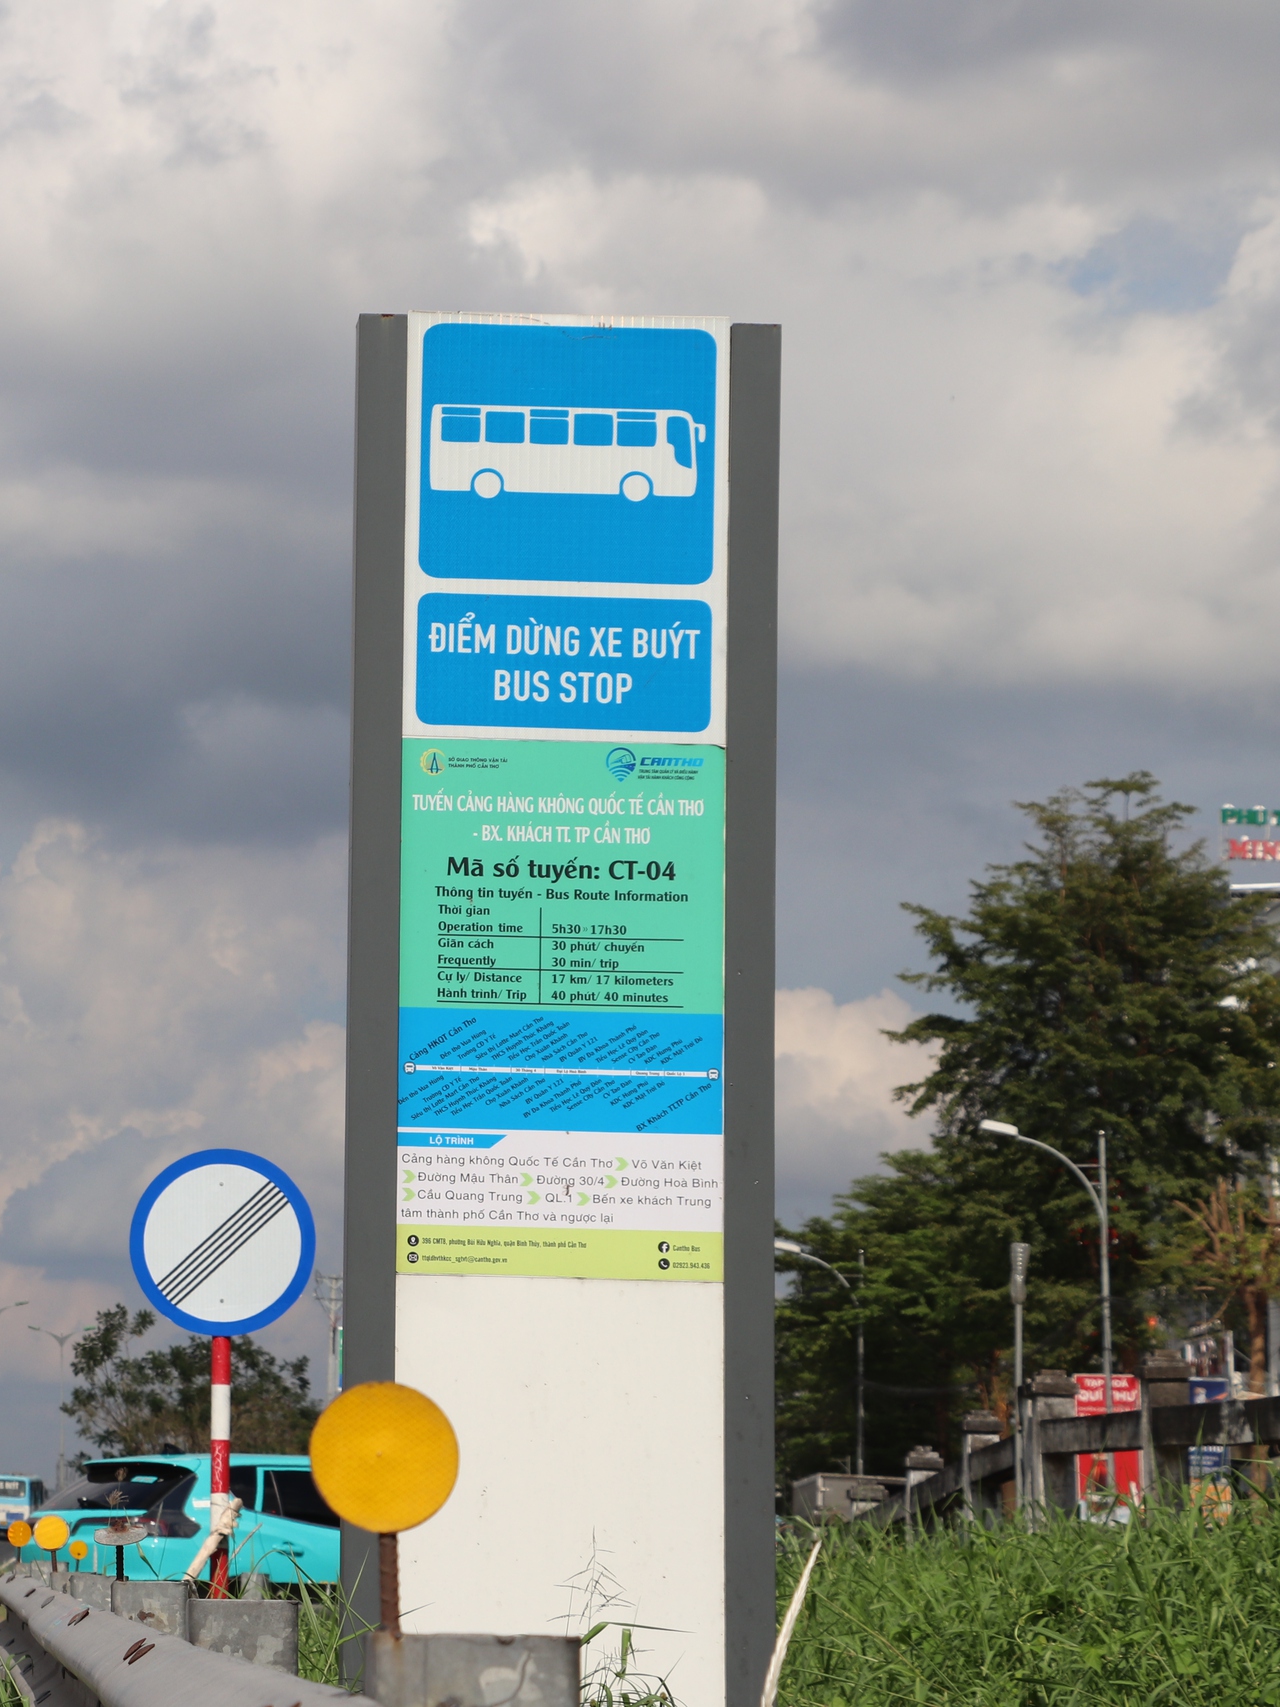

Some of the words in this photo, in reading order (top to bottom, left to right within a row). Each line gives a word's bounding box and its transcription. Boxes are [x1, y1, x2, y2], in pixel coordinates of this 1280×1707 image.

[429, 612, 495, 654] ĐIỂM
[506, 617, 580, 657] DỪNG
[589, 626, 623, 658] XE
[632, 621, 701, 659] BUÝT
[494, 669, 550, 702] BUS
[559, 671, 633, 704] STOP
[640, 757, 704, 767] CANTHO
[411, 787, 453, 811] TUYẾN
[456, 789, 493, 812] CẢNG
[496, 791, 534, 813] HÀNG
[537, 792, 584, 814] KHÔNG
[587, 790, 625, 816] QUỐC
[627, 791, 644, 815] TẾ
[646, 791, 674, 816] CẦN
[676, 798, 704, 816] THƠ
[481, 824, 503, 842] BX.
[506, 820, 552, 842] KHÁCH
[554, 825, 571, 843] TT.
[573, 826, 590, 843] TP
[592, 819, 621, 844] CẦN
[623, 826, 651, 844] THƠ
[446, 856, 484, 877] Mã
[492, 854, 520, 878] số
[526, 856, 600, 883] tuyến:
[607, 859, 676, 881] CT-04
[434, 885, 473, 901] Thông
[476, 886, 494, 898] tin
[497, 886, 532, 901] tuyến
[545, 887, 570, 900] Bus
[573, 888, 610, 901] Route
[614, 889, 688, 902] Information
[437, 903, 462, 915] Thời
[465, 904, 490, 917] gian
[437, 920, 493, 933] Operation
[497, 922, 523, 933] time
[551, 923, 581, 934] 5h30
[590, 924, 627, 935] 17h30
[467, 938, 494, 949] cách
[551, 939, 566, 951] 30
[569, 940, 600, 953] phút/
[603, 940, 644, 954] chuyến
[436, 953, 497, 967] Frequently
[551, 956, 566, 967] 30
[569, 957, 596, 968] min/
[599, 958, 619, 971] trip
[436, 970, 453, 983] Cự
[455, 970, 470, 984] ly/
[473, 971, 522, 983] Distance
[551, 973, 566, 984] 17
[569, 973, 592, 984] km/
[595, 974, 610, 985] 17
[613, 974, 674, 986] kilometers
[436, 987, 467, 1001] Hành
[470, 988, 503, 999] trình/
[505, 988, 527, 1002] Trip
[550, 989, 566, 1001] 40
[569, 990, 600, 1003] phút/
[603, 991, 619, 1002] 40
[622, 991, 668, 1003] minutes
[429, 1134, 443, 1147] LỘ
[445, 1134, 474, 1146] TRÌNH
[401, 1152, 432, 1166] Cảng
[436, 1153, 465, 1167] hàng
[468, 1154, 504, 1168] không
[507, 1155, 539, 1167] Quốc
[542, 1155, 559, 1167] Tế
[561, 1156, 586, 1168] Cần
[589, 1157, 613, 1168] Thơ
[630, 1159, 648, 1169] Võ
[650, 1159, 674, 1170] Văn
[678, 1159, 701, 1171] Kiệt
[417, 1171, 456, 1185] Đường
[459, 1172, 485, 1184] Mậu
[488, 1172, 518, 1184] Thân
[535, 1174, 575, 1189] Đường
[578, 1175, 604, 1186] 30/4
[620, 1176, 660, 1190] Đường
[663, 1177, 688, 1188] Hoà
[691, 1177, 718, 1188] Bình
[416, 1188, 441, 1200] Cầu
[444, 1189, 484, 1203] Quang
[487, 1190, 523, 1205] Trung
[592, 1192, 615, 1204] Bến
[619, 1196, 633, 1205] xe
[637, 1194, 672, 1206] khách
[676, 1195, 711, 1209] Trung
[400, 1207, 422, 1218] tâm
[425, 1208, 459, 1219] thành
[462, 1208, 485, 1221] phố
[488, 1208, 512, 1220] Cần
[516, 1210, 539, 1221] Thơ
[542, 1211, 556, 1222] và
[560, 1213, 596, 1224] ngược
[600, 1212, 613, 1224] lại
